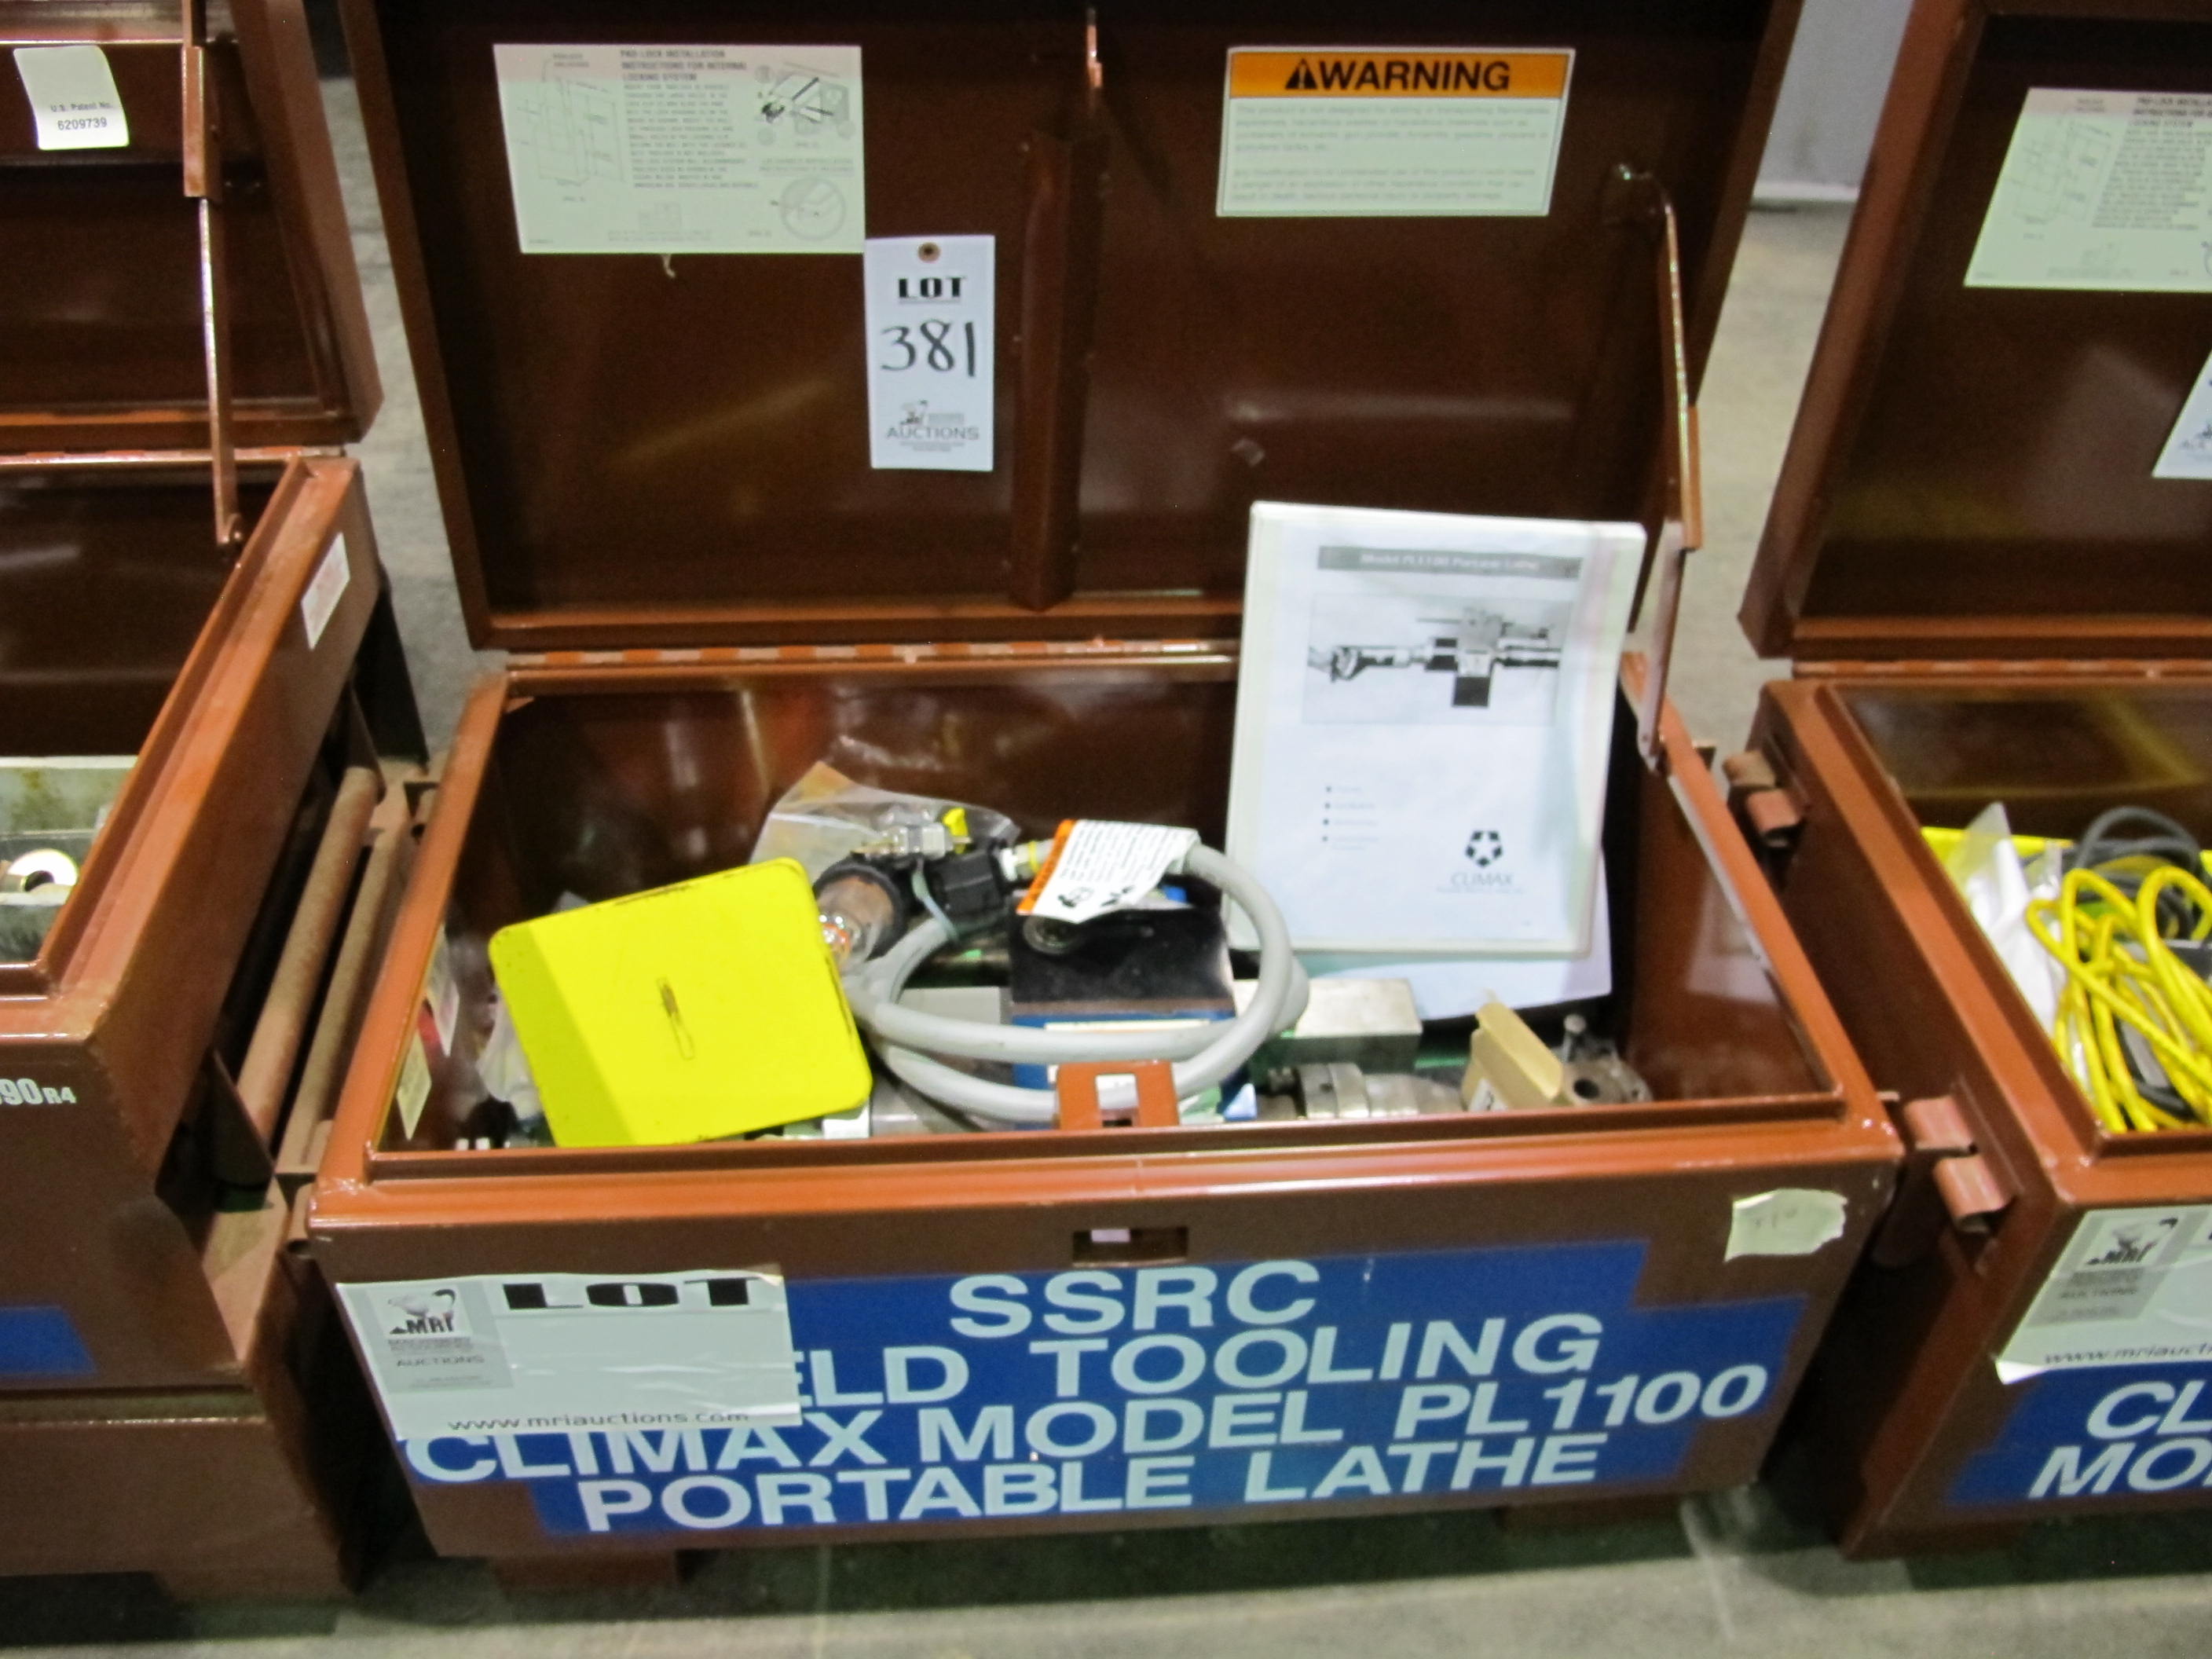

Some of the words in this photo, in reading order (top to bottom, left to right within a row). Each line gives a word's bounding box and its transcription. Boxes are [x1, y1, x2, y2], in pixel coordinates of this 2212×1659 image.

[1319, 60, 1511, 91] WARNING
[57, 116, 108, 131] 6209739
[898, 276, 966, 298] LOT
[881, 319, 976, 378] 381
[885, 427, 980, 440] AUCTIONS
[1450, 872, 1514, 887] CLIMAX
[0, 1078, 77, 1105] 90R4
[504, 1276, 768, 1310] LOT
[950, 1259, 1320, 1339] SSRC
[1030, 1313, 1602, 1397] TOOLING
[405, 1410, 886, 1482] CLIMAX
[917, 1390, 1343, 1463] MODEL
[1393, 1364, 1767, 1440] PL1100
[448, 1412, 749, 1431] www.mriauctions.com
[578, 1455, 1195, 1532] PORTABLE
[1243, 1433, 1608, 1503] LATHE
[2029, 1437, 2212, 1498] MO
